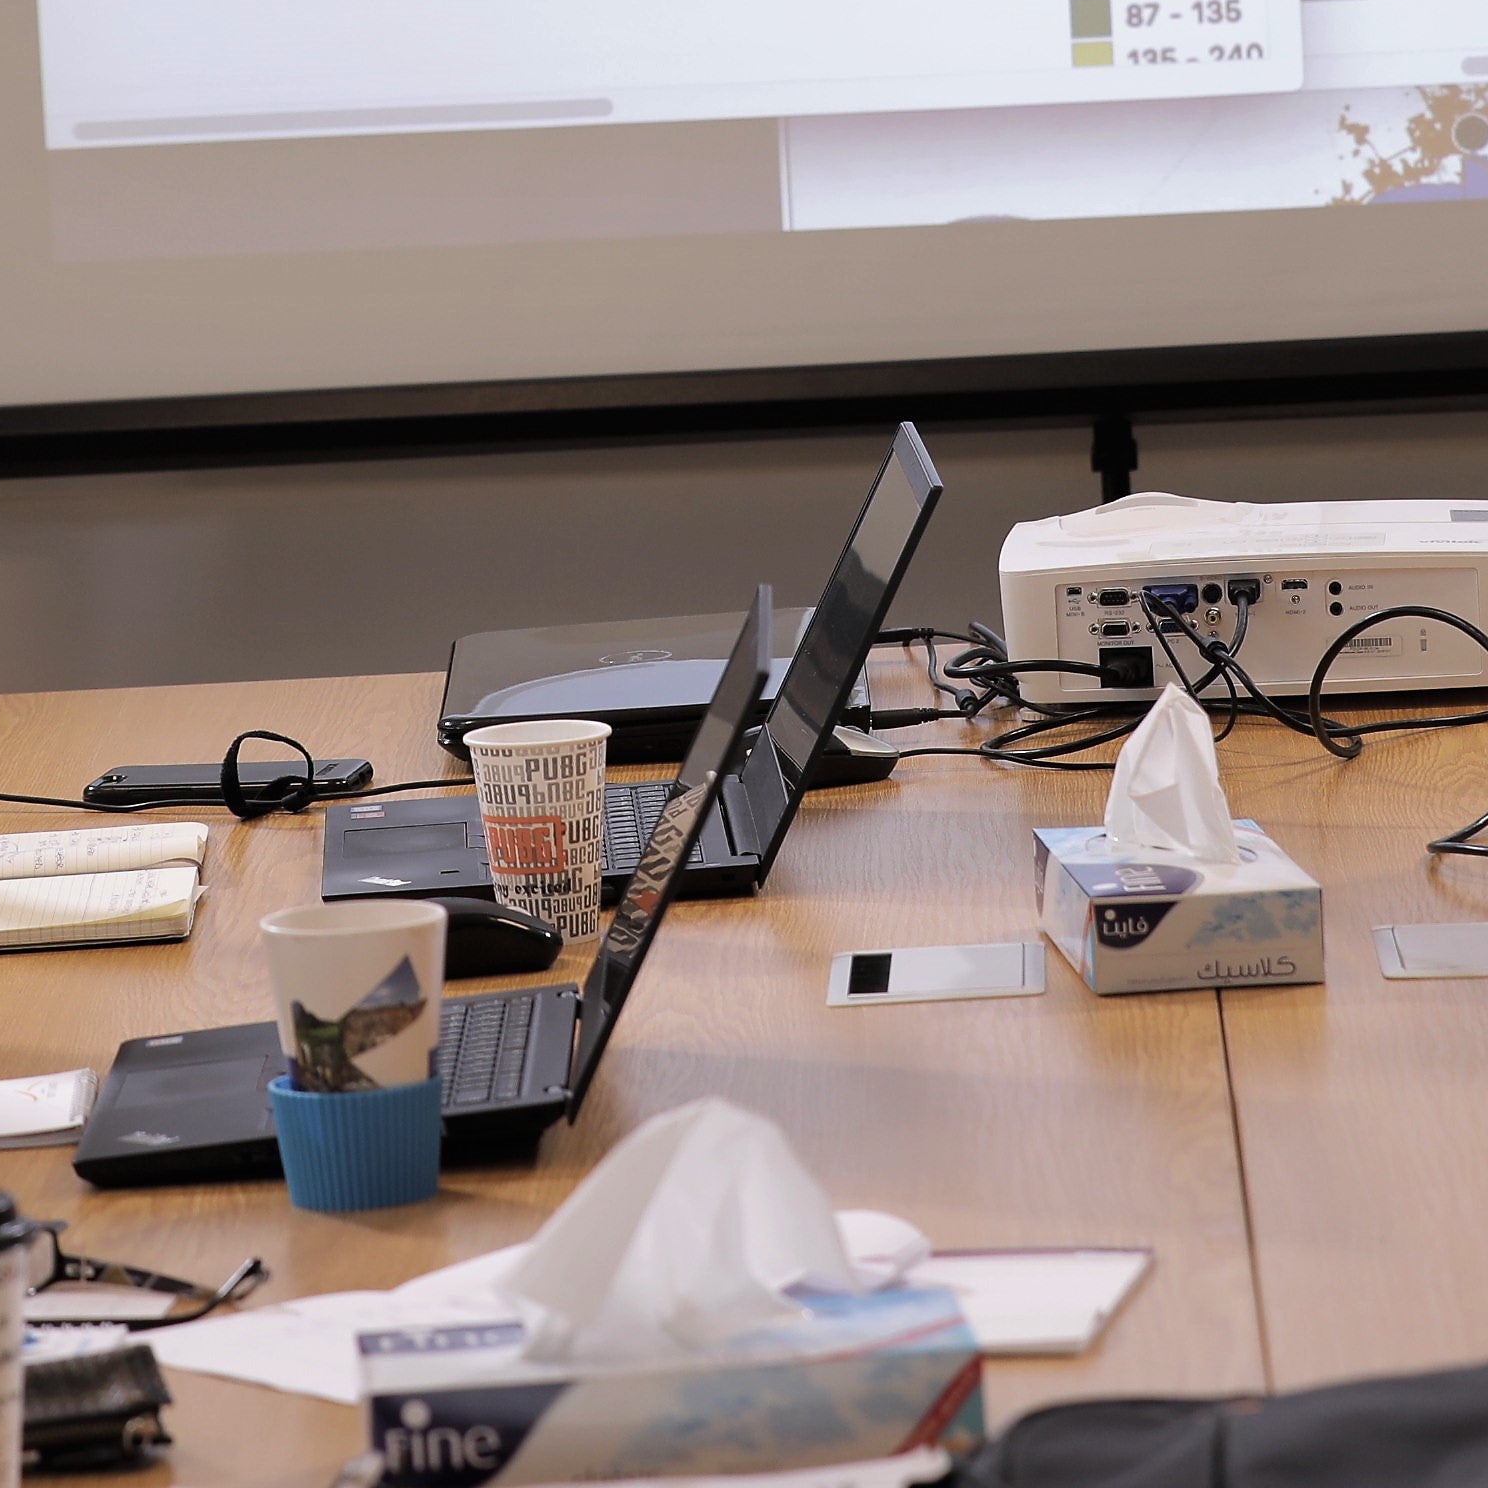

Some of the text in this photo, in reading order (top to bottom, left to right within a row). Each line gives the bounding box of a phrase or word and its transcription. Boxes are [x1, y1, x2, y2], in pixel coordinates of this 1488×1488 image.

[1124, 2, 1161, 28] 87
[525, 752, 588, 783] PUBG
[556, 910, 597, 938] PUBG
[1195, 954, 1298, 984] كلاسيك
